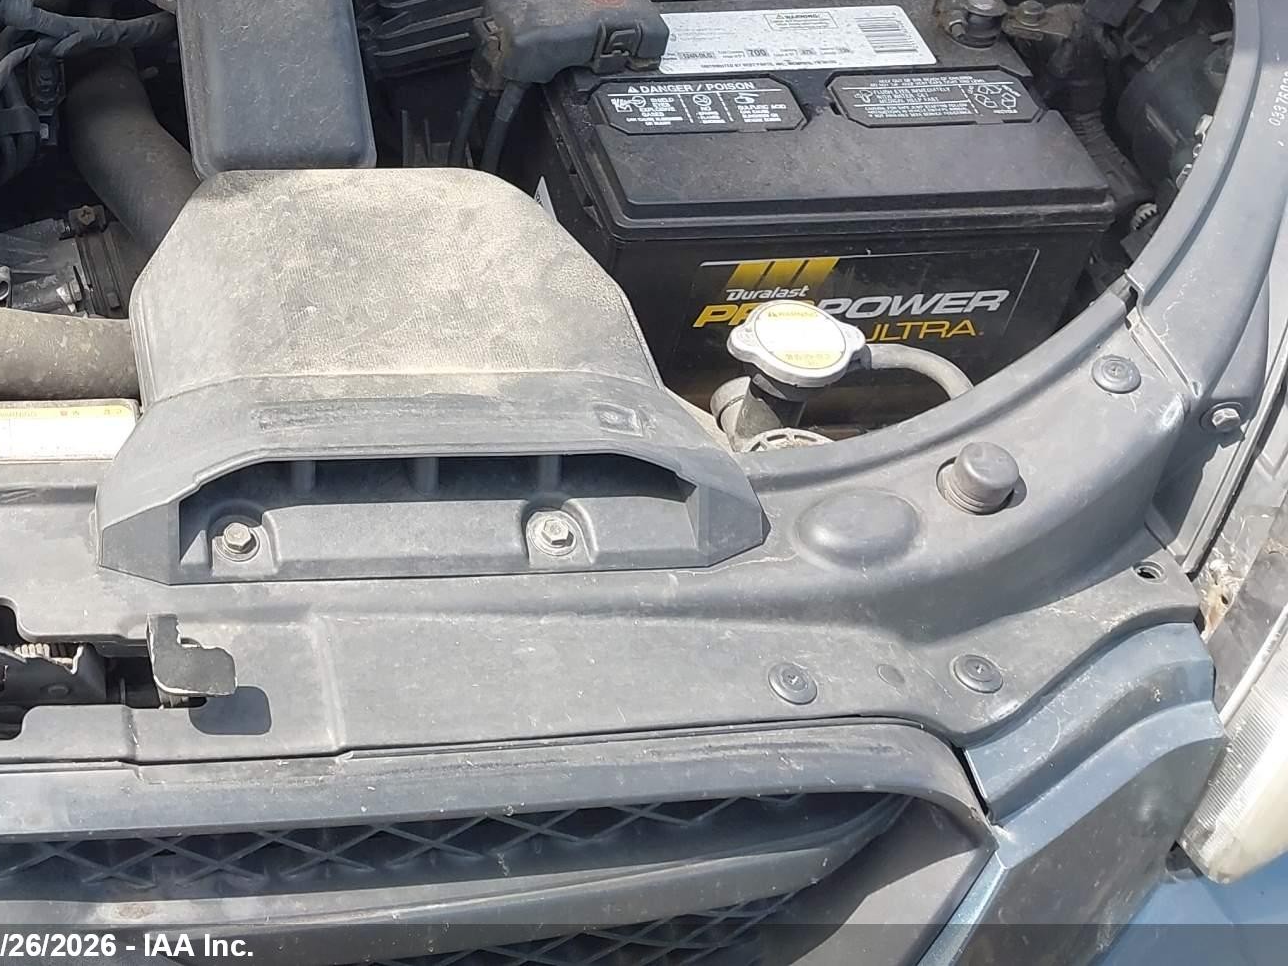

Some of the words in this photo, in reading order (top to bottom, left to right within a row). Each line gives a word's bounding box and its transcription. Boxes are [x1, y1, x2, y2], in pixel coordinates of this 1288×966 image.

[748, 48, 766, 57] 700
[639, 85, 694, 93] DANGER
[705, 81, 756, 91] POISON
[725, 284, 810, 302] Duralast
[817, 289, 1010, 319] POWER
